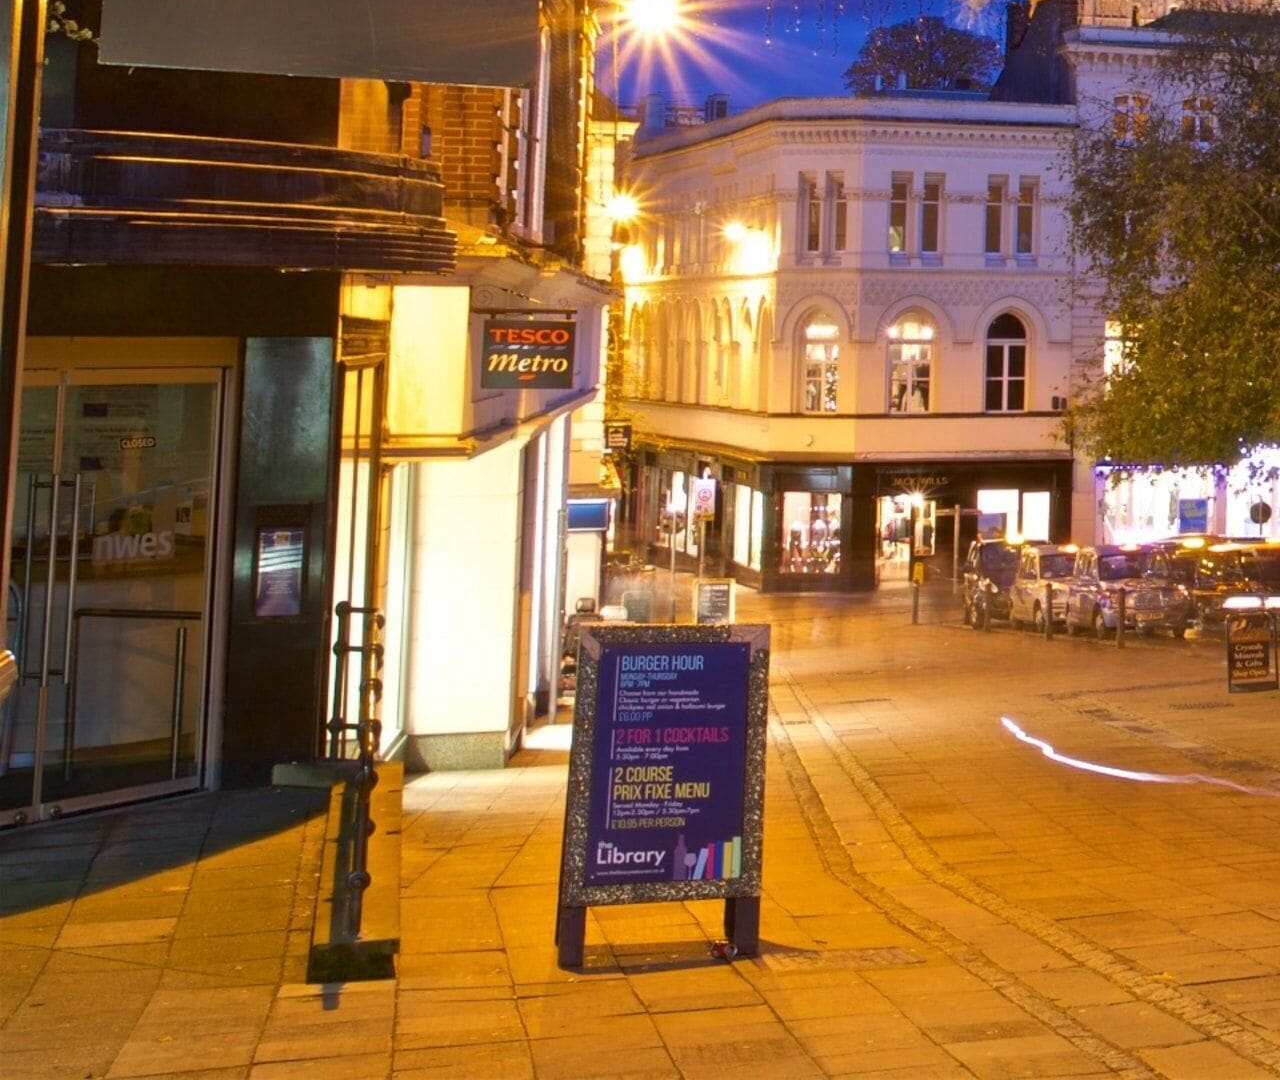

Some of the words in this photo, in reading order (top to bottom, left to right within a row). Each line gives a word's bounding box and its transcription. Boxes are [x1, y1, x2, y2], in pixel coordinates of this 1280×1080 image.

[489, 328, 569, 344] TESCO
[487, 353, 568, 372] Metro
[121, 438, 154, 449] CLOSED
[94, 531, 172, 561] nwes
[622, 655, 669, 671] BURGER
[672, 655, 704, 670] HOUR
[640, 697, 660, 705] burger
[674, 702, 680, 710] &
[706, 702, 726, 711] burger
[616, 728, 624, 744] 2
[628, 728, 651, 744] FOR
[664, 727, 729, 743] COCKTAILS
[614, 768, 622, 784] 2
[626, 766, 674, 782] COURSE
[614, 784, 642, 800] PRIX
[645, 784, 672, 799] FIXE
[674, 782, 710, 798] MENU
[664, 800, 684, 808] Friday
[638, 818, 654, 829] PER
[656, 817, 686, 828] PERSON
[598, 841, 613, 850] the
[597, 846, 666, 866] Library
